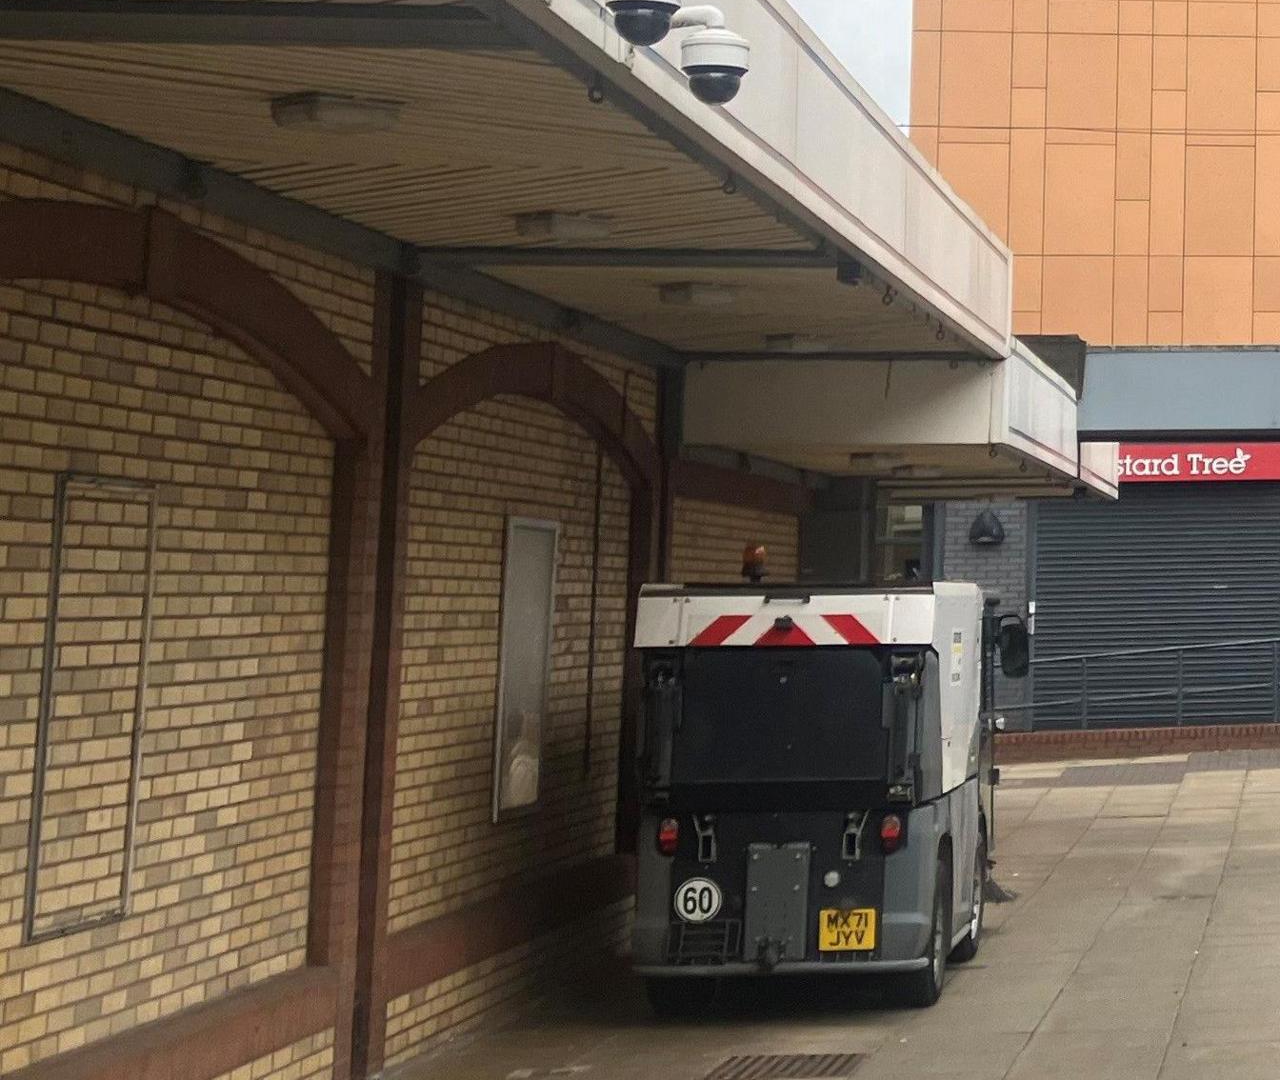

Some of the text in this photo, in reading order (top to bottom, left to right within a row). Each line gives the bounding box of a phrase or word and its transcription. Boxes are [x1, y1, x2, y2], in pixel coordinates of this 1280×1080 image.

[1187, 454, 1247, 475] Tree
[683, 886, 713, 914] 60
[827, 913, 868, 929] MX71
[829, 930, 865, 946] JYV
